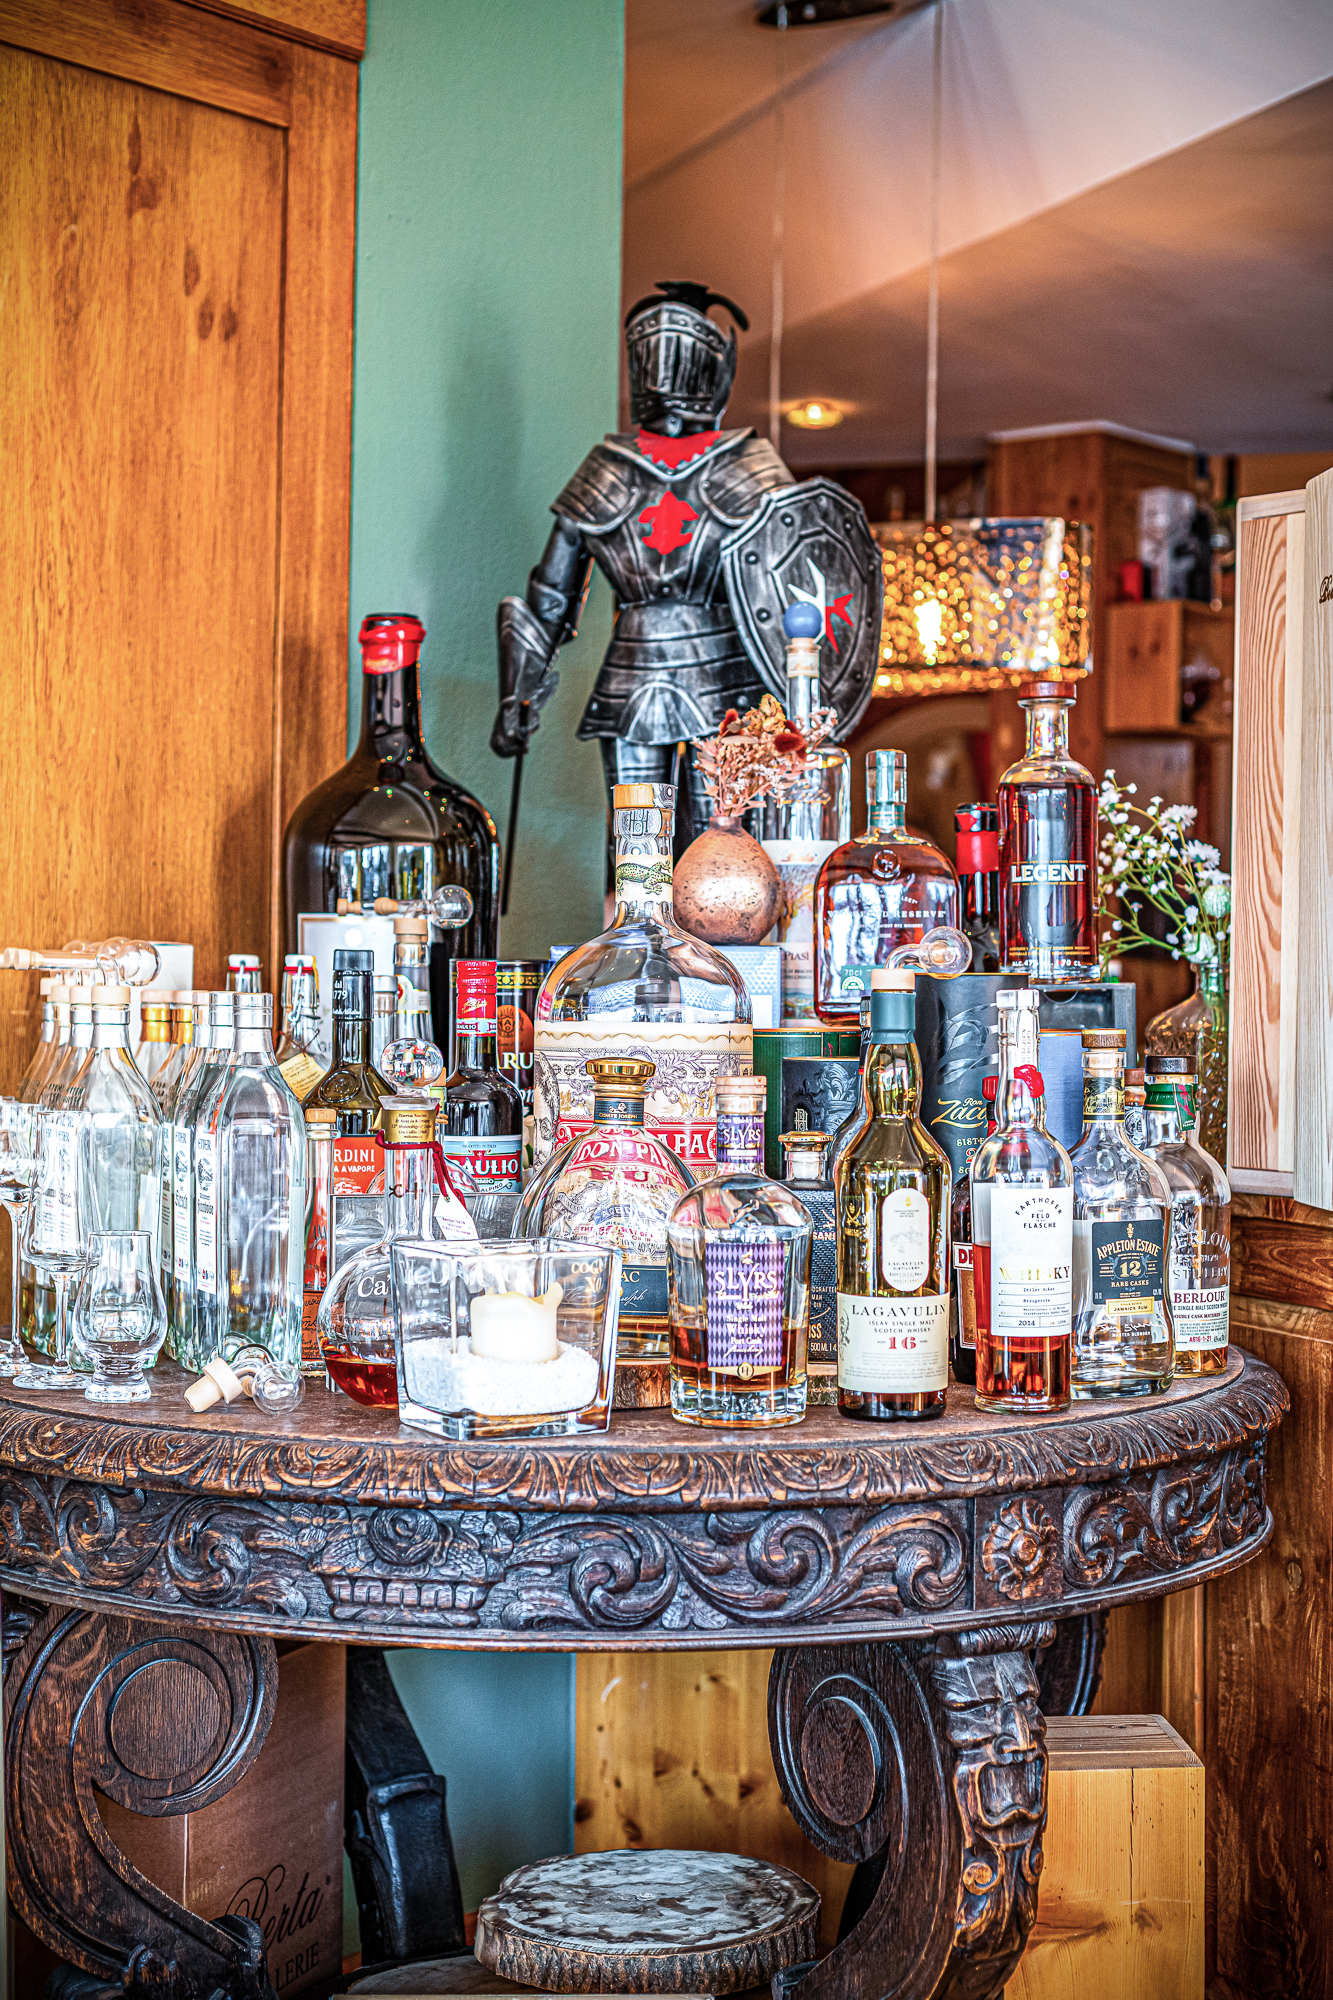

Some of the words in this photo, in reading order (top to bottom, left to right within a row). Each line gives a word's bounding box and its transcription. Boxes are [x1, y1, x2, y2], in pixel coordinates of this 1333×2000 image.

[1011, 864, 1086, 882] LEGENT
[894, 910, 944, 918] RESERVE
[498, 1052, 534, 1070] RU
[962, 1097, 984, 1107] Ron
[930, 1098, 988, 1129] Zaca
[723, 1122, 761, 1149] SLYRS
[334, 1148, 375, 1163] RDINI
[341, 1165, 347, 1173] A
[347, 1165, 376, 1173] VAPORE
[480, 1182, 503, 1193] ALPINO
[1015, 1197, 1063, 1216] FARTHOFER
[1096, 1238, 1136, 1260] APPLETON
[1136, 1238, 1162, 1257] ESTATE
[999, 1265, 1070, 1281] WHISKY
[1119, 1260, 1142, 1278] 12
[714, 1262, 778, 1301] SLYRS
[1173, 1290, 1226, 1304] BERLOUR
[852, 1303, 946, 1318] LAGAVULIN
[726, 1322, 767, 1338] Whisky
[731, 1336, 745, 1345] Port
[888, 1336, 917, 1350] 16
